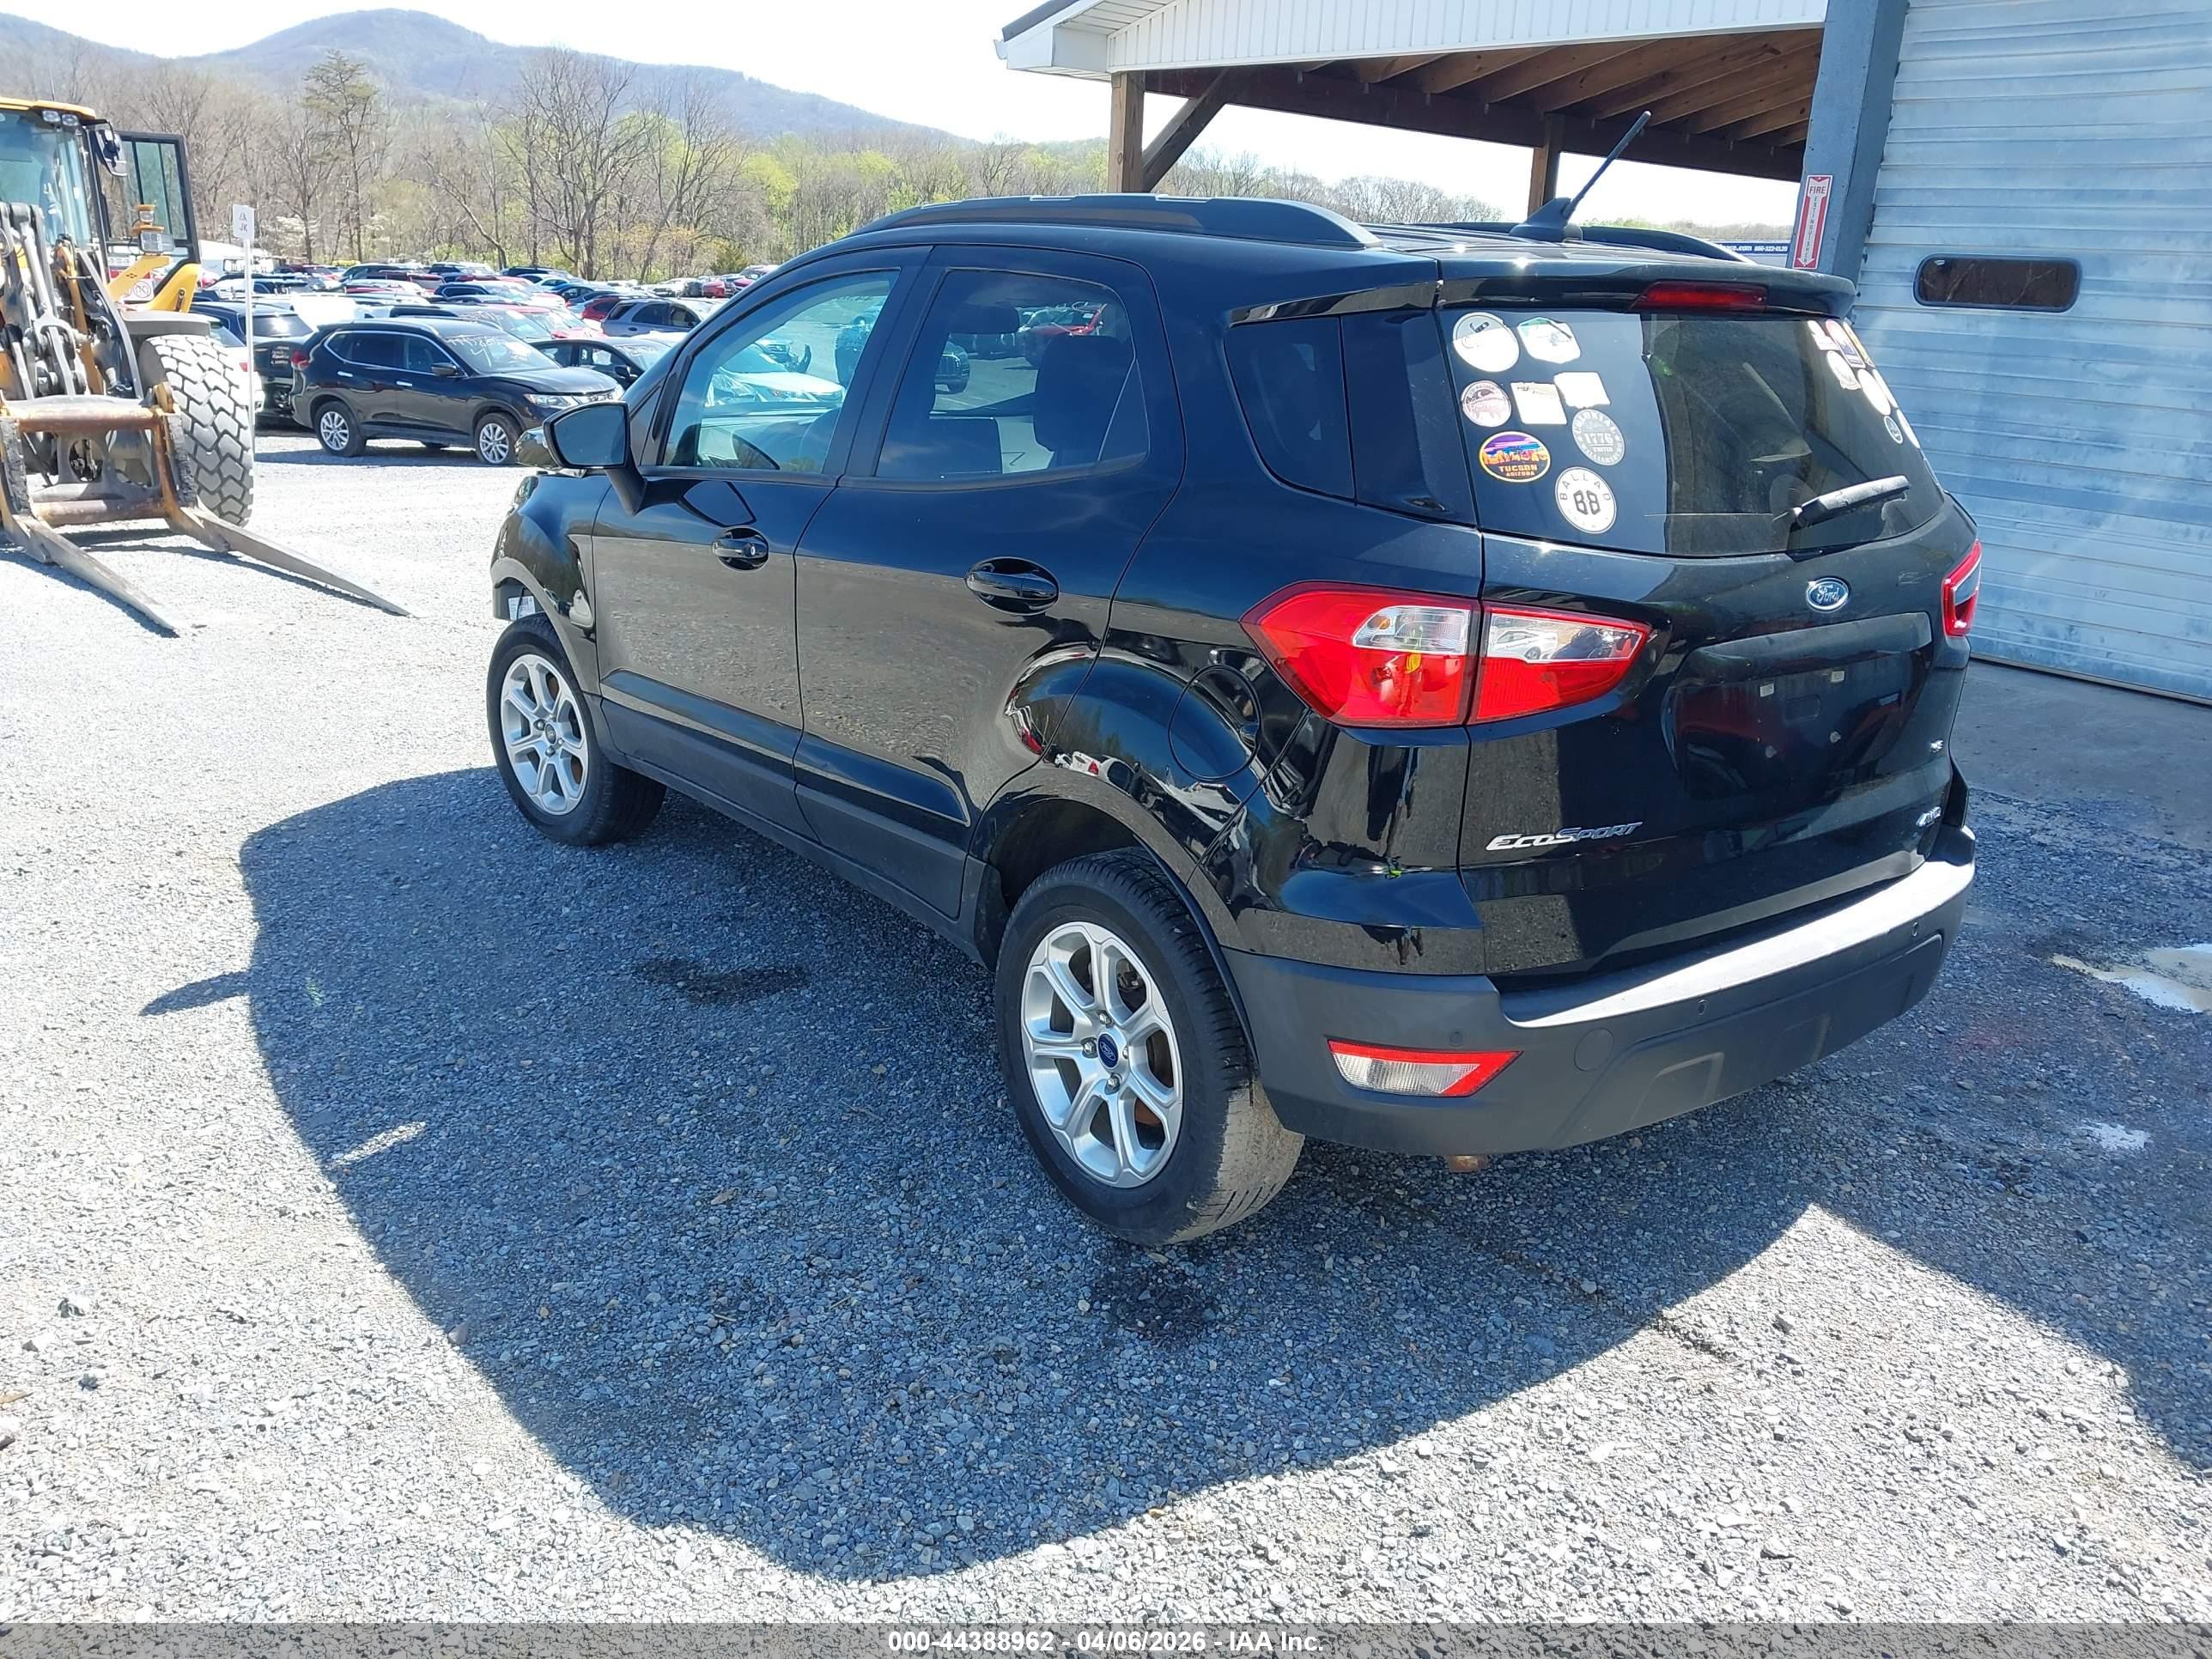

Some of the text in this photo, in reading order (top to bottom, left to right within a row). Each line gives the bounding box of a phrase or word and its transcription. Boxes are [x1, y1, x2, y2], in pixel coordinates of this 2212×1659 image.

[1808, 185, 1826, 194] FIRE
[1804, 196, 1818, 263] EXTINGUISHER
[1583, 432, 1614, 445] 1776
[1498, 464, 1538, 472] TUCSON
[1559, 473, 1611, 501] BALLAD
